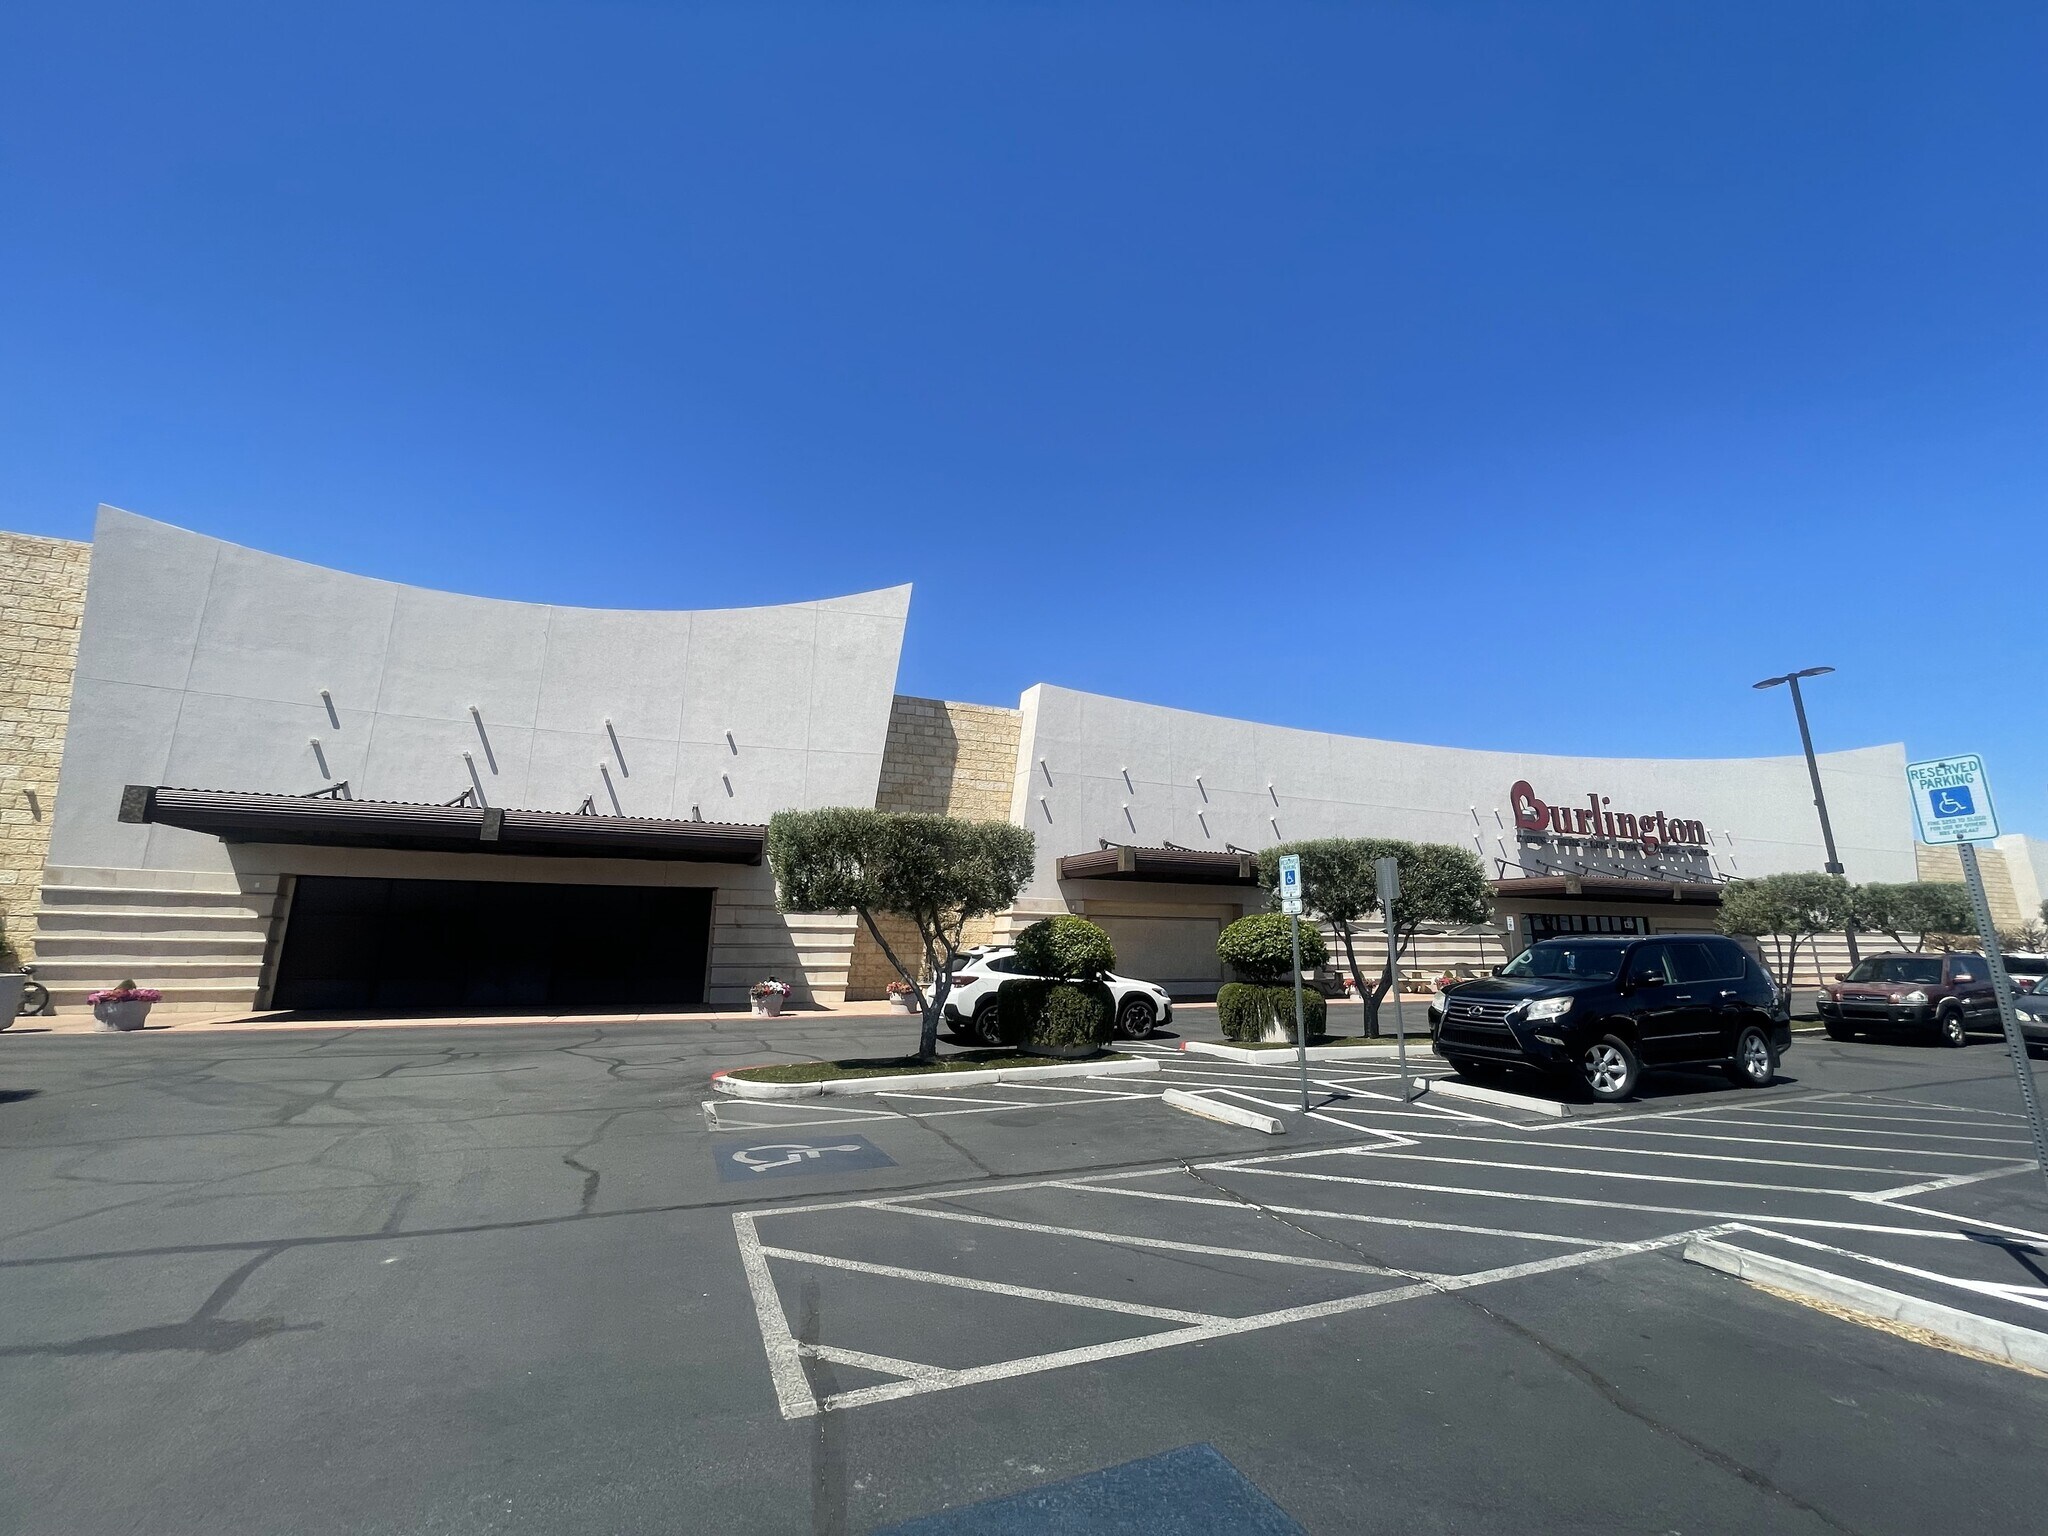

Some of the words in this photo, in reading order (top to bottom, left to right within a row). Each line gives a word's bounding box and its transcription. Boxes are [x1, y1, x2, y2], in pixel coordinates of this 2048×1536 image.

[1910, 761, 1978, 780] RESERVED
[1919, 773, 1974, 790] PARKING
[1510, 780, 1709, 856] Burlington
